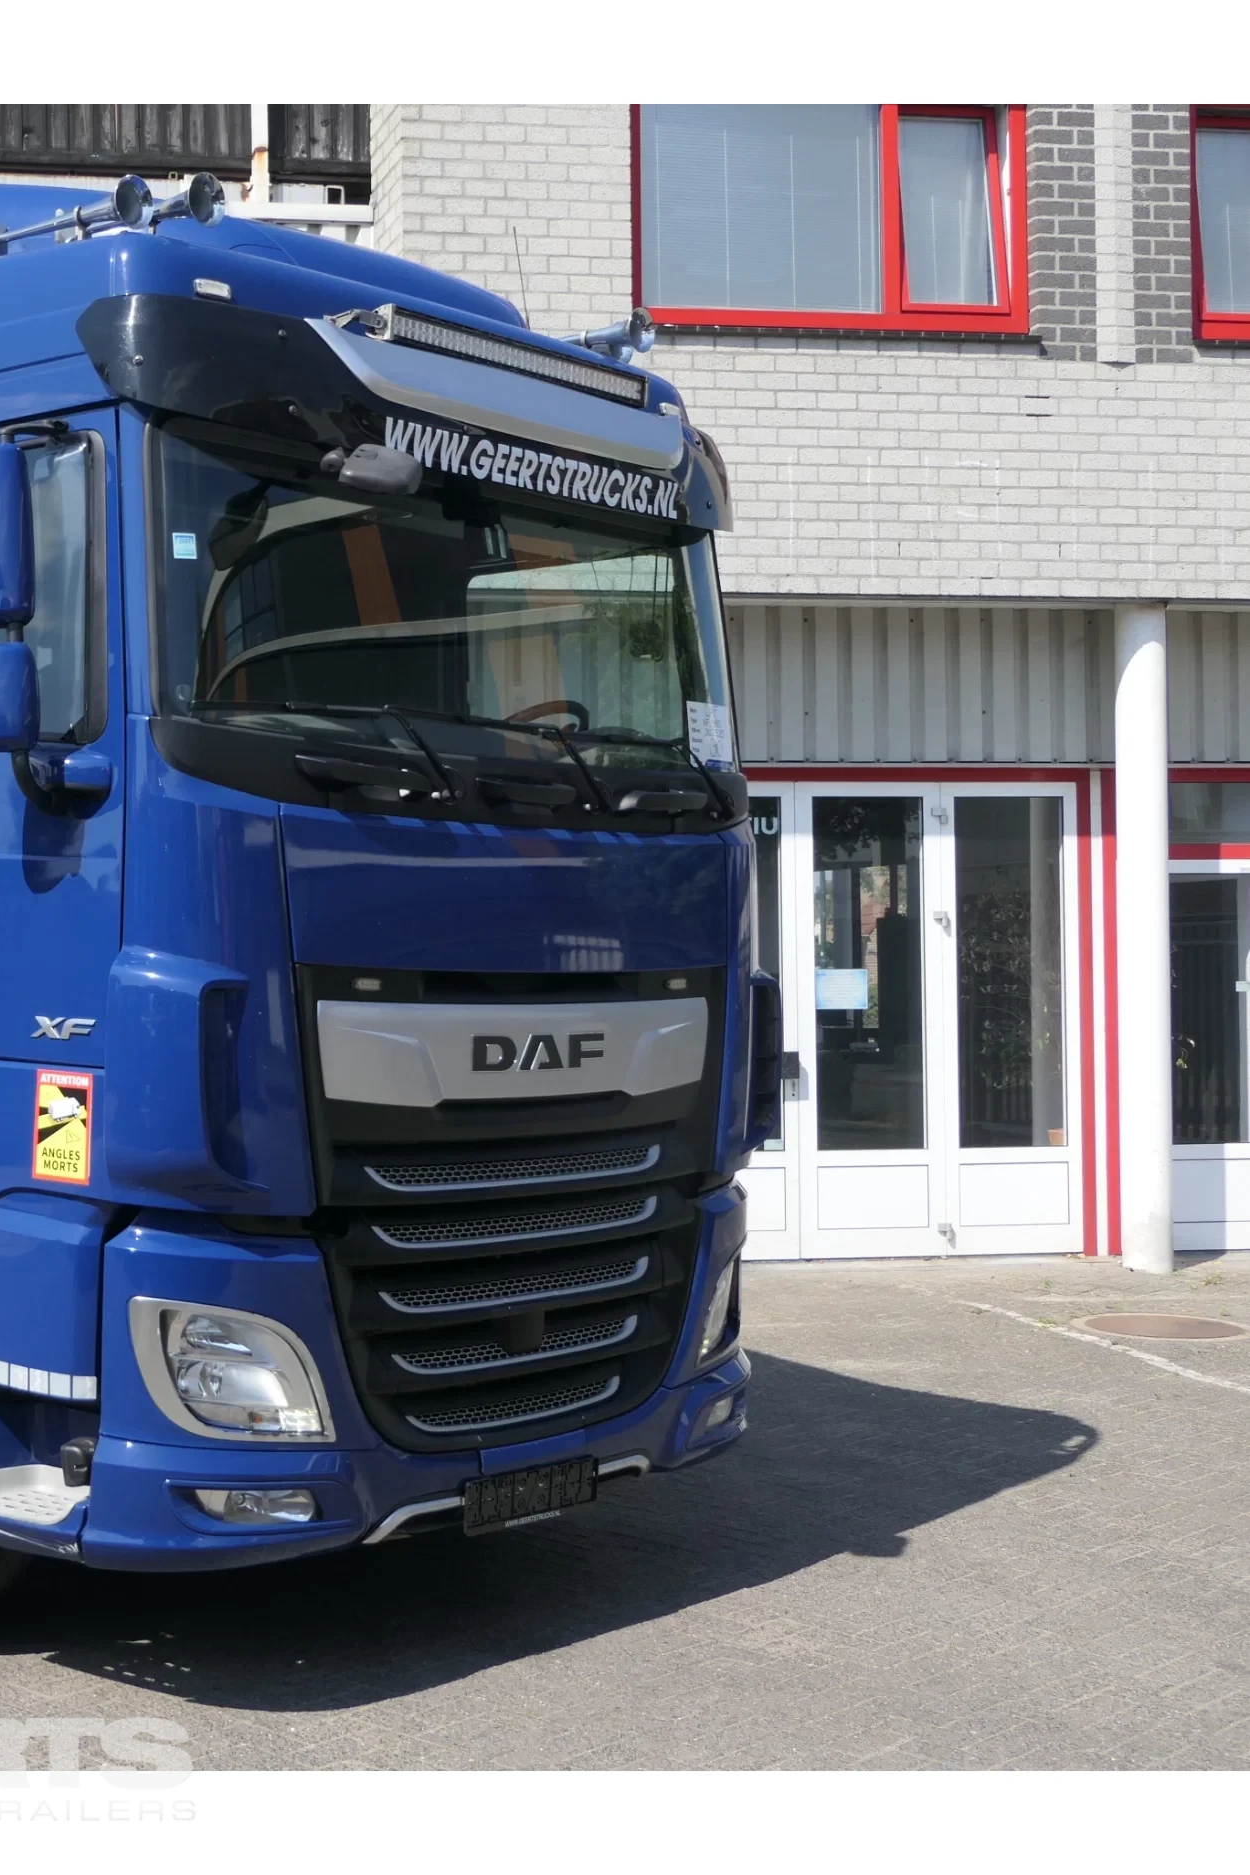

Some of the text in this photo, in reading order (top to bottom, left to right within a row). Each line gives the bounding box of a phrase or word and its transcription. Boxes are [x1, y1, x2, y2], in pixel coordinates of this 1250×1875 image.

[384, 416, 678, 519] WWW.GEERTSTRUCKS.NL
[748, 816, 778, 835] IU
[30, 1015, 96, 1040] XF
[471, 1032, 605, 1073] DAF
[40, 1073, 89, 1086] ATTENTION
[42, 1147, 81, 1161] ANGLES
[43, 1160, 78, 1173] MORTS
